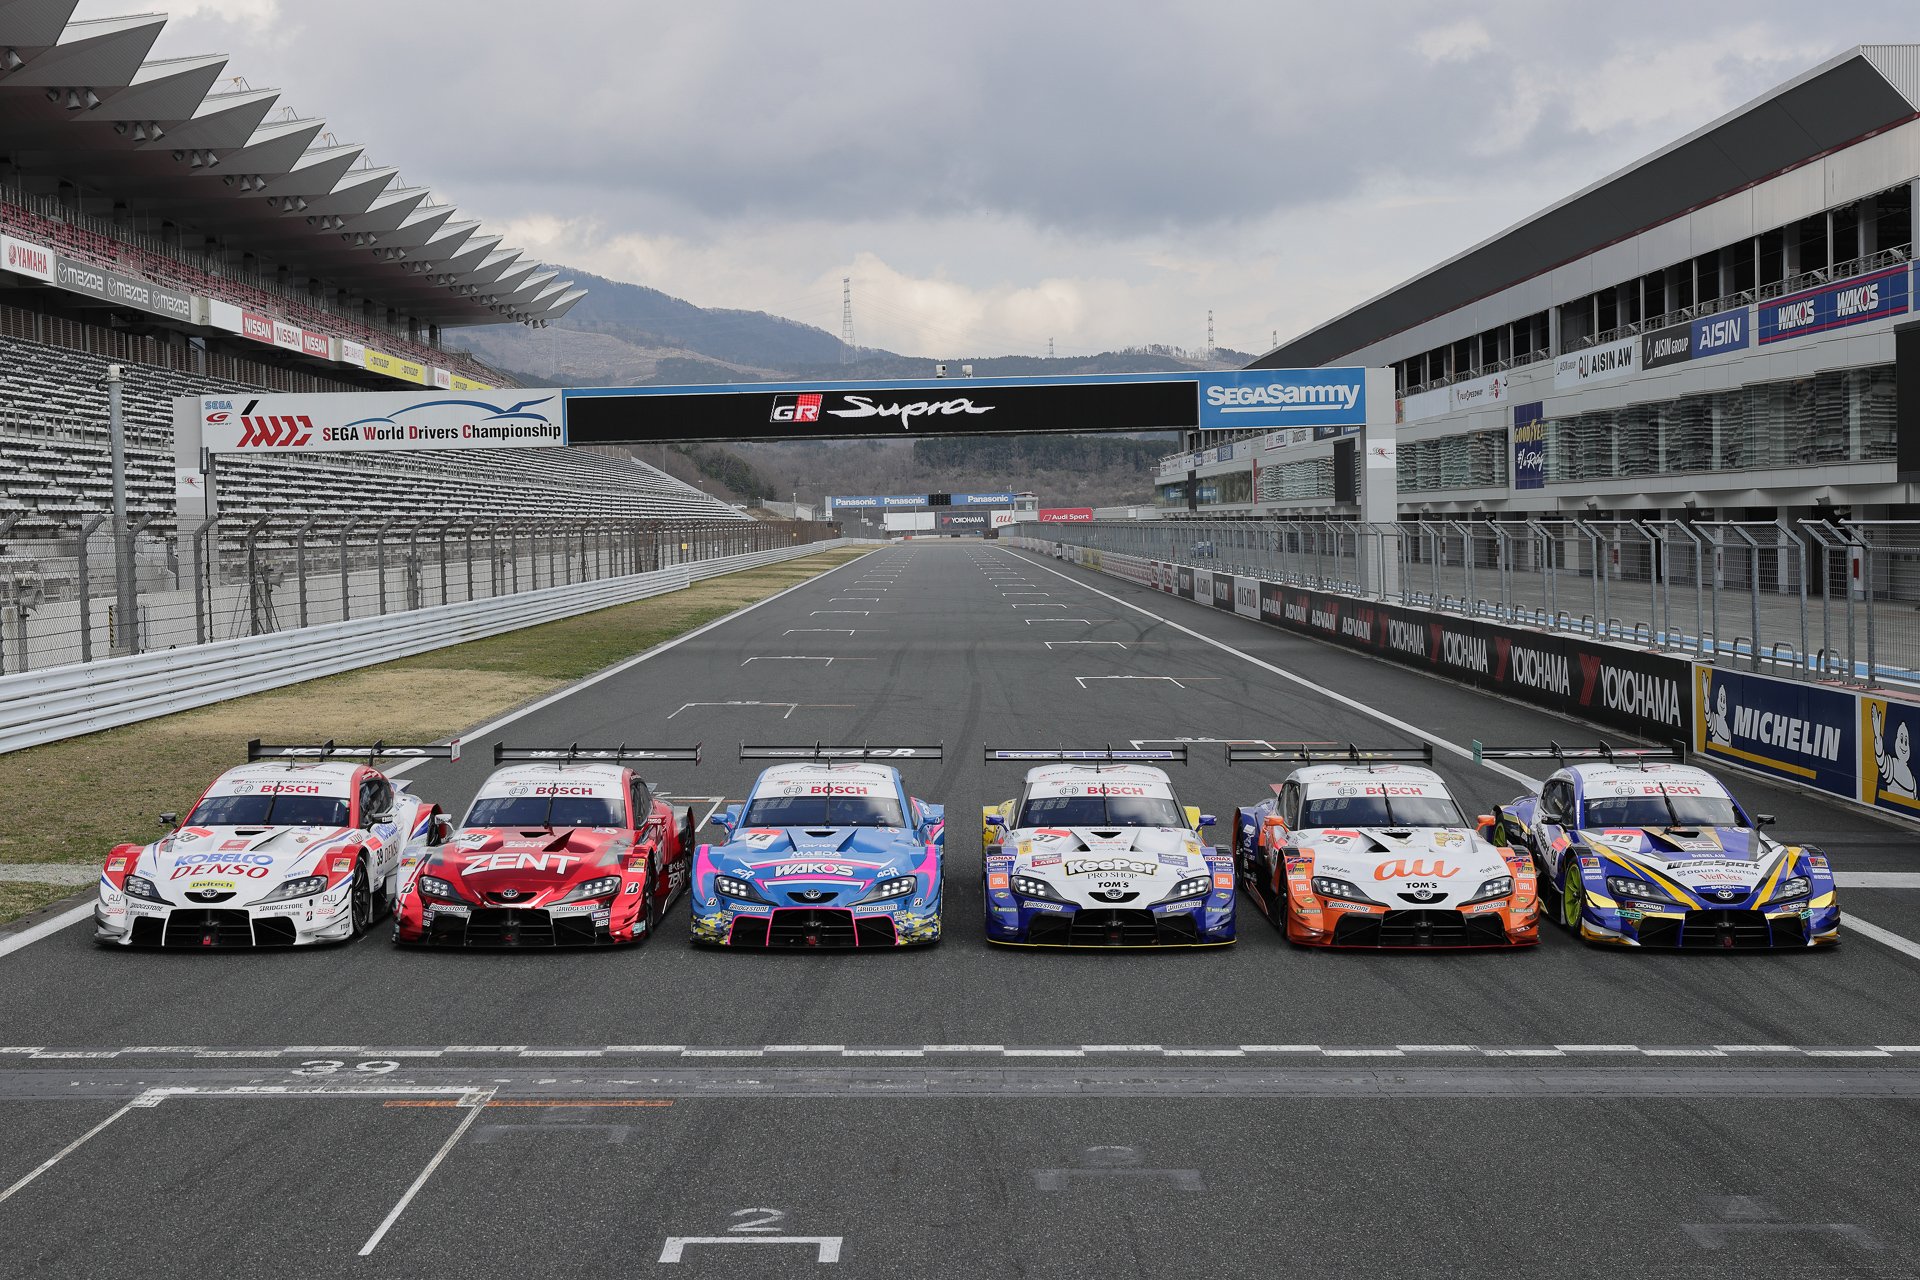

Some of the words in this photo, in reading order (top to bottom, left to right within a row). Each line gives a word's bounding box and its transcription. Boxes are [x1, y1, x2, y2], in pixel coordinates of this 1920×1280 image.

[17, 246, 48, 275] YAMAHA
[67, 267, 104, 292] mazda
[116, 281, 149, 304] mazda
[161, 294, 190, 316] mazda
[245, 317, 272, 339] NISSAN
[1699, 317, 1741, 350] AISIN
[276, 327, 301, 346] NISSAN
[304, 335, 327, 354] NISSAN
[1654, 338, 1671, 358] AISIN
[1671, 337, 1689, 354] GROUP
[1591, 351, 1615, 374] AISIN
[1617, 346, 1633, 368] AW
[205, 400, 233, 410] SEGA
[773, 405, 818, 420] GR
[827, 395, 995, 430] Supra
[322, 427, 359, 442] SEGA
[363, 426, 404, 441] World
[409, 425, 458, 440] Drivers
[462, 423, 561, 441] Championship
[835, 498, 877, 506] Panasonic
[884, 497, 925, 505] Panasonic
[967, 495, 1009, 503] Panasonic
[1051, 513, 1071, 521] Audi
[1072, 513, 1090, 521] Sport
[1237, 586, 1256, 608] NISMO
[1262, 598, 1281, 616] ADVAN
[1285, 603, 1307, 623] ADVAN
[1311, 609, 1336, 631] ADVAN
[1342, 616, 1371, 641] ADVAN
[1388, 618, 1425, 656] YOKOHAMA
[1442, 630, 1488, 673] YOKOHAMA
[1511, 645, 1571, 696] YOKOHAMA
[1600, 664, 1682, 727] YOKOHAMA
[1733, 704, 1842, 762] MICHELIN
[260, 785, 319, 794] BOSCH
[535, 786, 593, 795] BOSCH
[811, 786, 868, 794] BOSCH
[1087, 786, 1144, 795] BOSCH
[1365, 787, 1422, 795] BOSCH
[1643, 786, 1701, 795] BOSCH
[460, 833, 487, 842] 38
[747, 833, 768, 842] 14
[1033, 834, 1060, 843] 37
[1324, 835, 1351, 845] 36
[1611, 834, 1634, 843] 19
[174, 853, 274, 867] KOBELCO
[461, 853, 580, 876] ZENT
[1666, 860, 1760, 870] WedsSport
[170, 863, 269, 880] DENSO
[877, 867, 899, 879] 4CR
[1065, 858, 1157, 876] KeePer
[1373, 859, 1461, 881] au
[1725, 868, 1758, 876] CLUTCH
[732, 868, 755, 880] 4CR
[1518, 882, 1532, 890] JBL
[130, 903, 163, 911] BRIDGESTONE
[259, 903, 303, 911] BRIDGESTONE
[556, 904, 598, 912] BRIDGESTONE
[730, 903, 769, 912] BRIDGESTONE
[857, 904, 897, 912] BRIDGESTONE
[1024, 901, 1062, 911] BRIDGESTONE
[1167, 901, 1202, 911] BRIDGESTONE
[1329, 902, 1369, 912] BRIDGESTONE
[1474, 901, 1507, 912] BRIDGESTONE
[1634, 902, 1662, 911] YOKOHAMA
[291, 1060, 400, 1077] 39
[726, 1207, 786, 1231] 2
